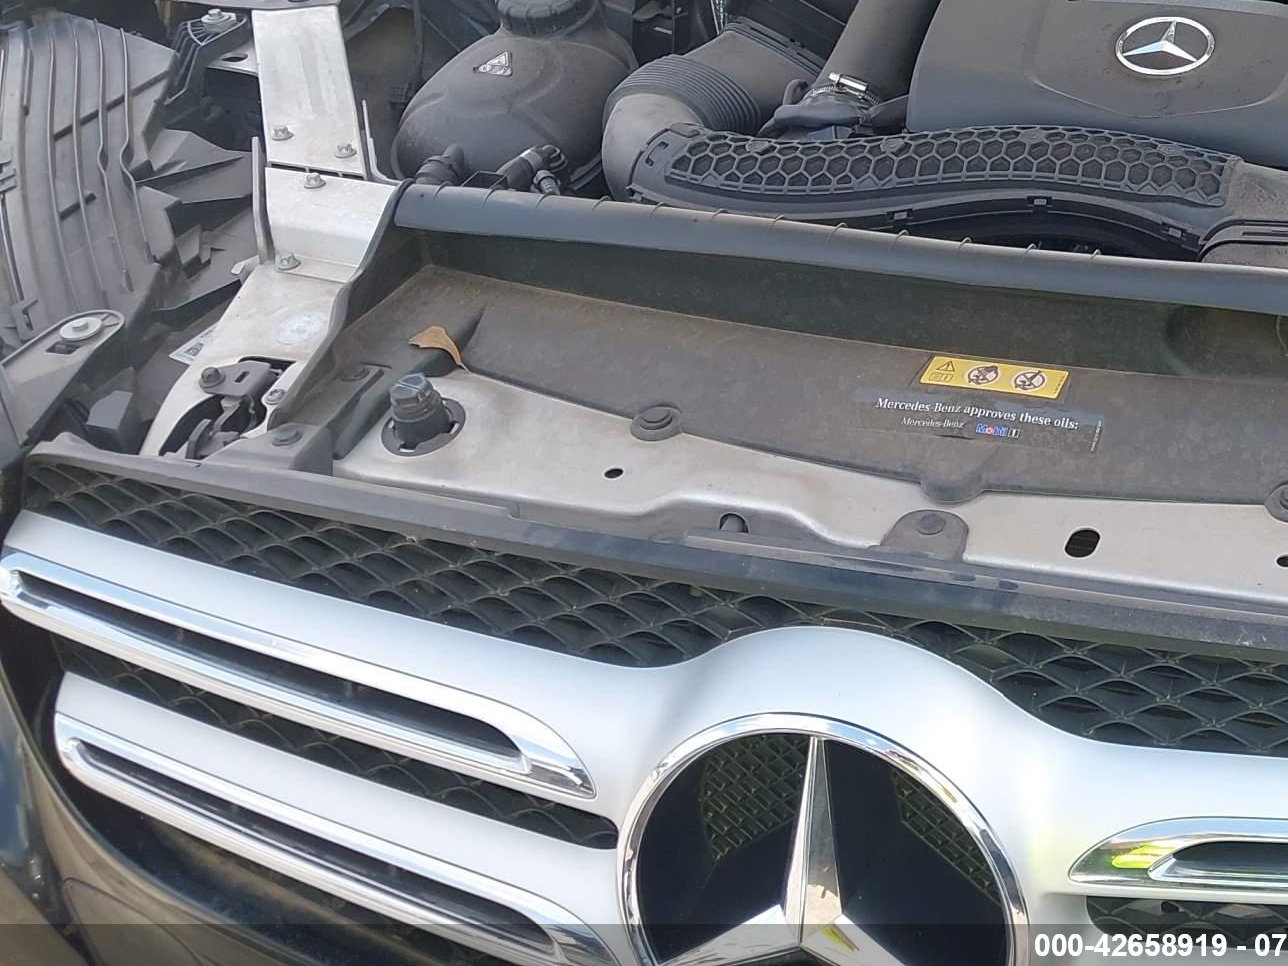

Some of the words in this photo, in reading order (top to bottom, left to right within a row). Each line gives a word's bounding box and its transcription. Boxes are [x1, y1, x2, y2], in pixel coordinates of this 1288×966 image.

[875, 397, 962, 413] Mercedes-Benz
[963, 405, 1017, 422] approves
[1019, 412, 1052, 425] these
[1053, 417, 1080, 430] oils:
[901, 417, 965, 428] Mercedes-Benz
